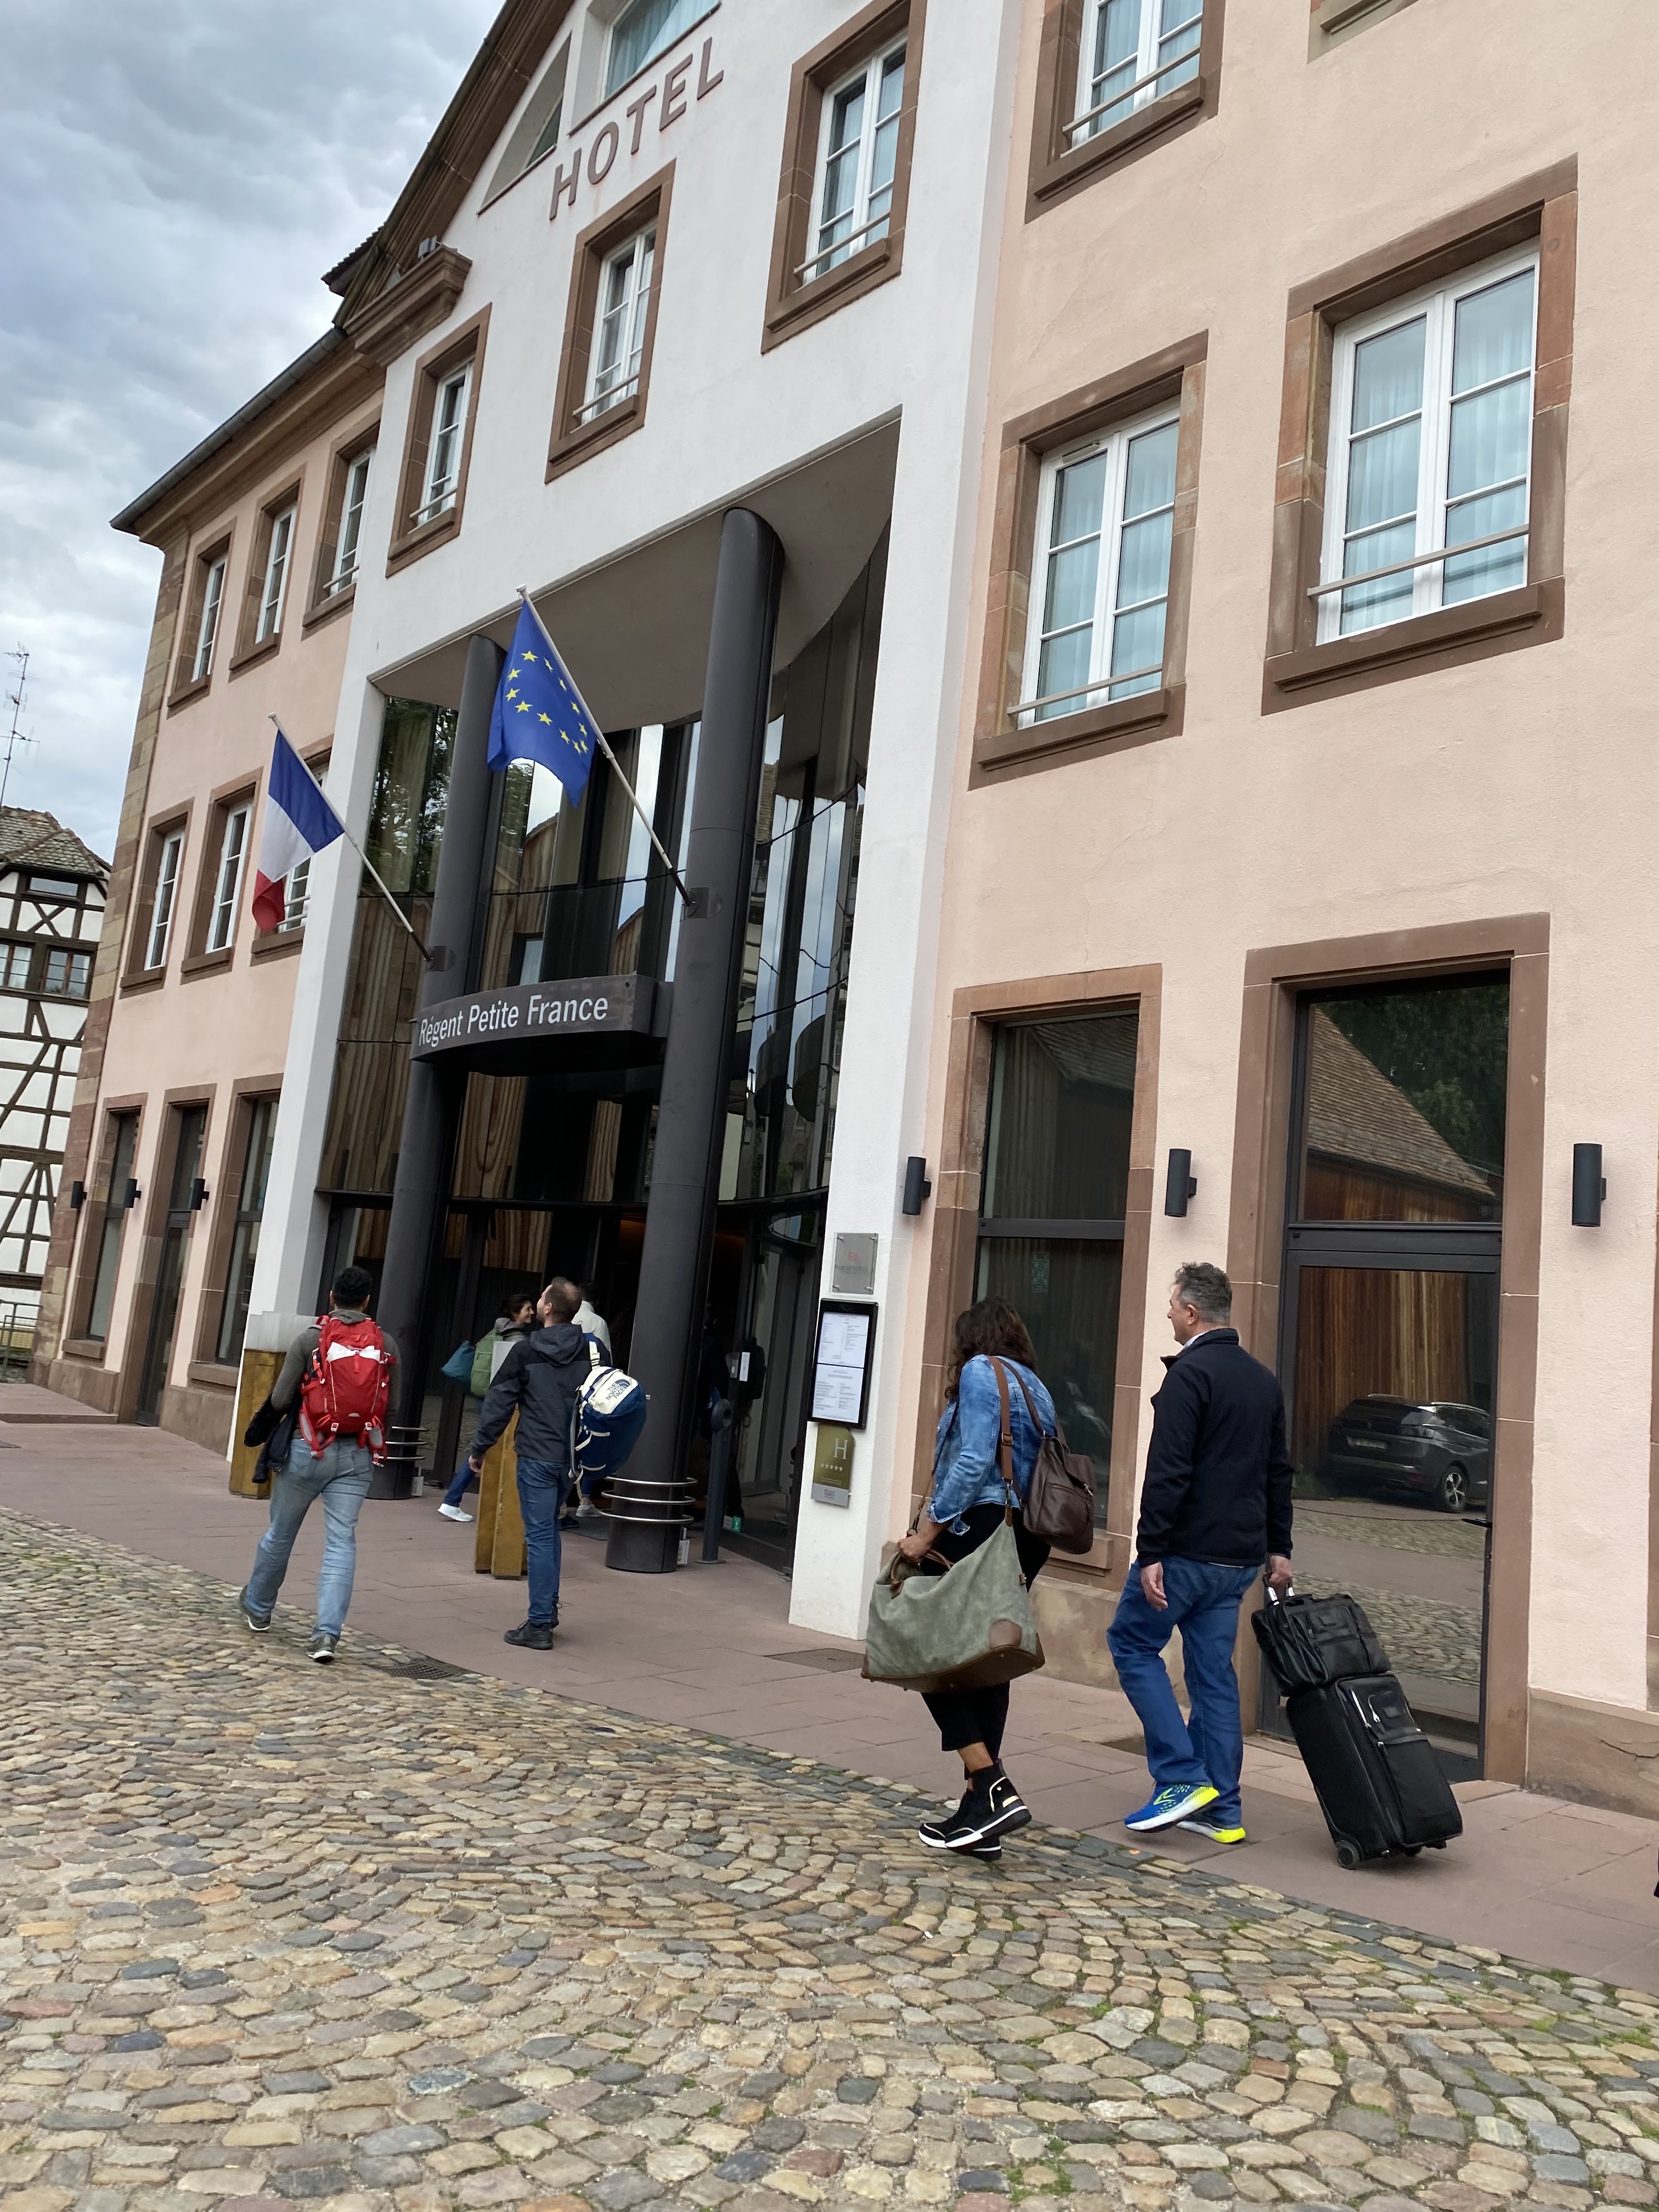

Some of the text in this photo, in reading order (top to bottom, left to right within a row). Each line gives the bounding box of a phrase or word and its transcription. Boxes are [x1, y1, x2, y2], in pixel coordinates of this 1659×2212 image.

[549, 36, 725, 222] HOTEL
[419, 995, 609, 1047] Régent Petite France
[606, 1385, 621, 1400] NORTH
[613, 1387, 625, 1398] FACE
[833, 1438, 849, 1460] H
